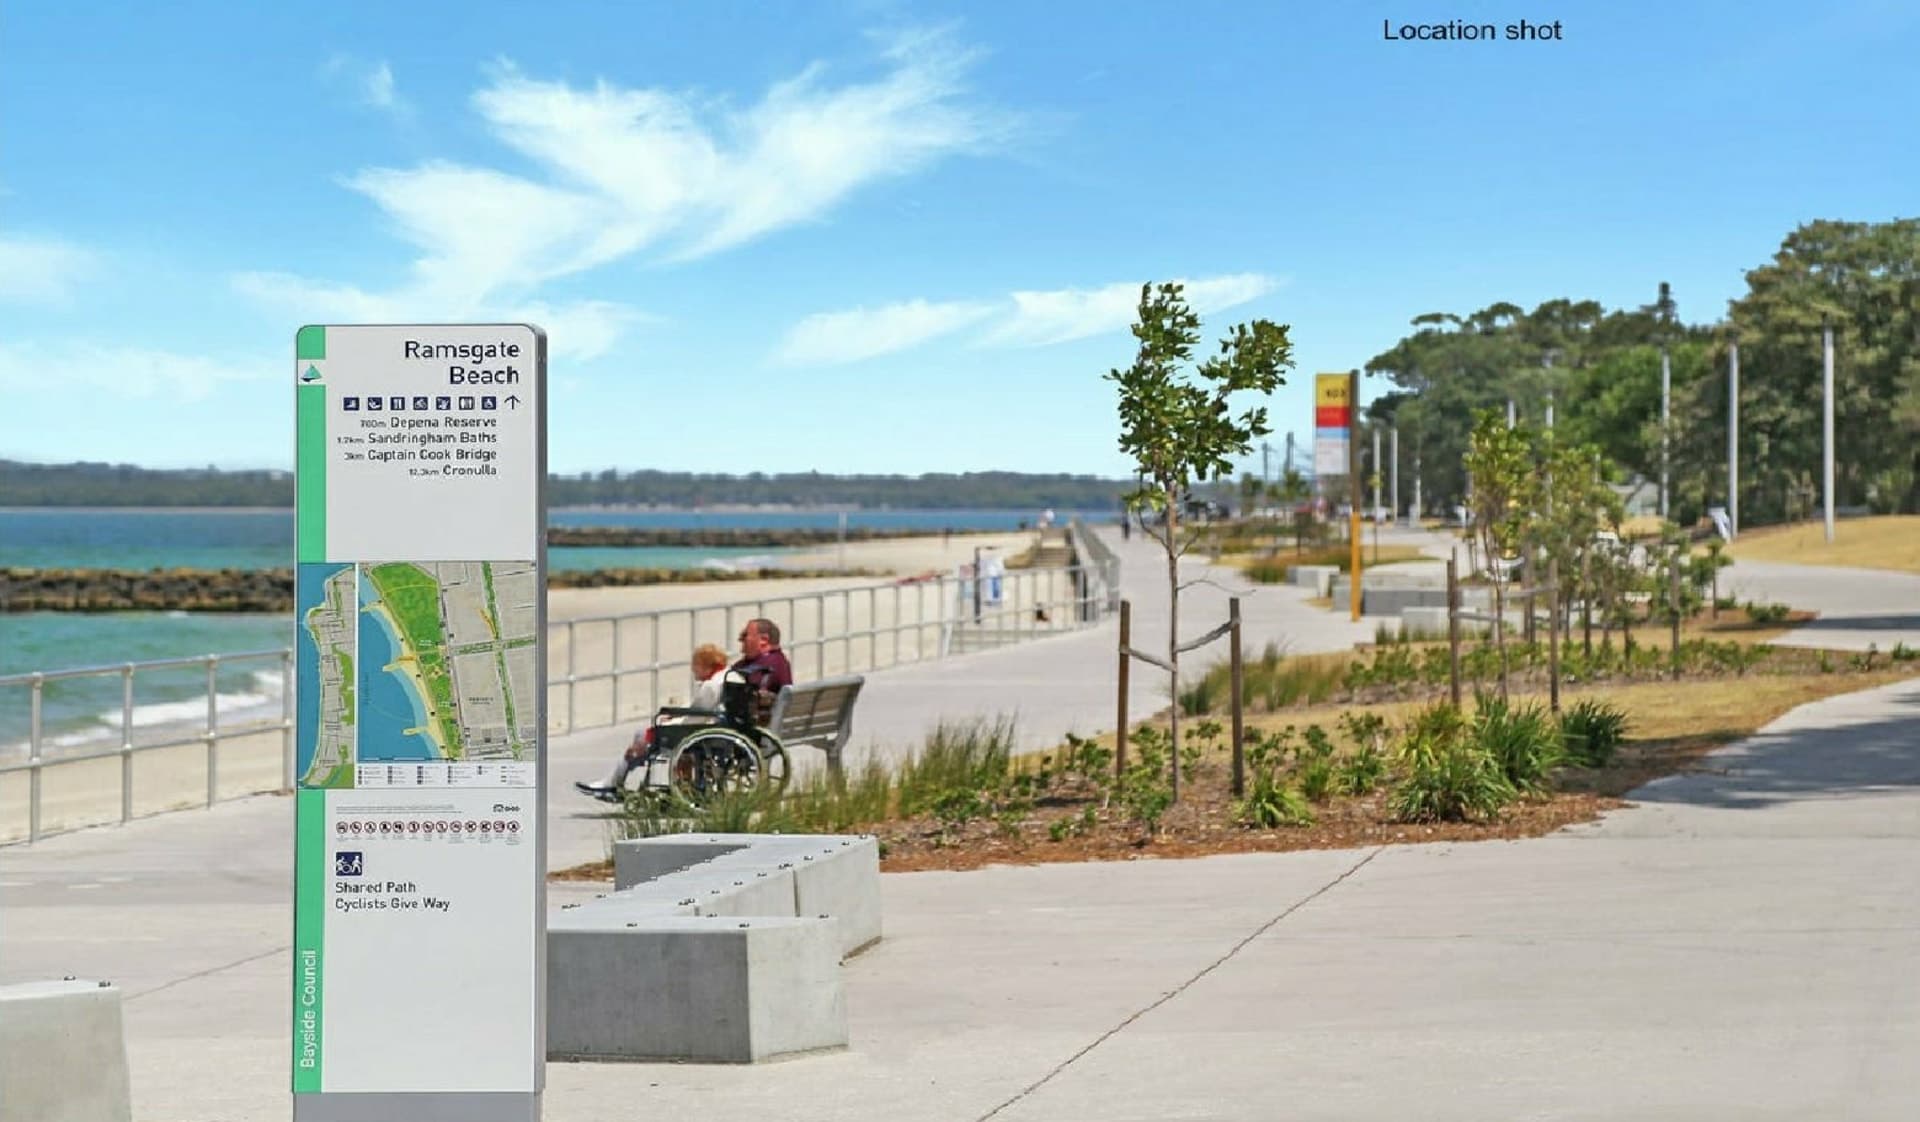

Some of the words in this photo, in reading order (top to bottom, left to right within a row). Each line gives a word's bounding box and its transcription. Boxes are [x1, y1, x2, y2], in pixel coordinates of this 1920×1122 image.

[404, 340, 521, 364] Ramsgate
[449, 366, 519, 385] Beach
[391, 417, 439, 429] Depena
[445, 417, 497, 427] Reserve
[368, 432, 457, 446] Sandringham
[460, 432, 497, 443] Baths
[368, 449, 416, 462] Captain
[419, 449, 452, 460] Cook
[456, 449, 497, 462] Bridge
[443, 464, 497, 476] Cronulla
[335, 881, 382, 894] Shared
[386, 881, 417, 893] Path
[335, 897, 387, 912] Cyclists
[391, 897, 418, 909] Give
[423, 897, 451, 912] Way
[302, 950, 316, 1006] Council
[300, 1009, 317, 1068] Bayside
